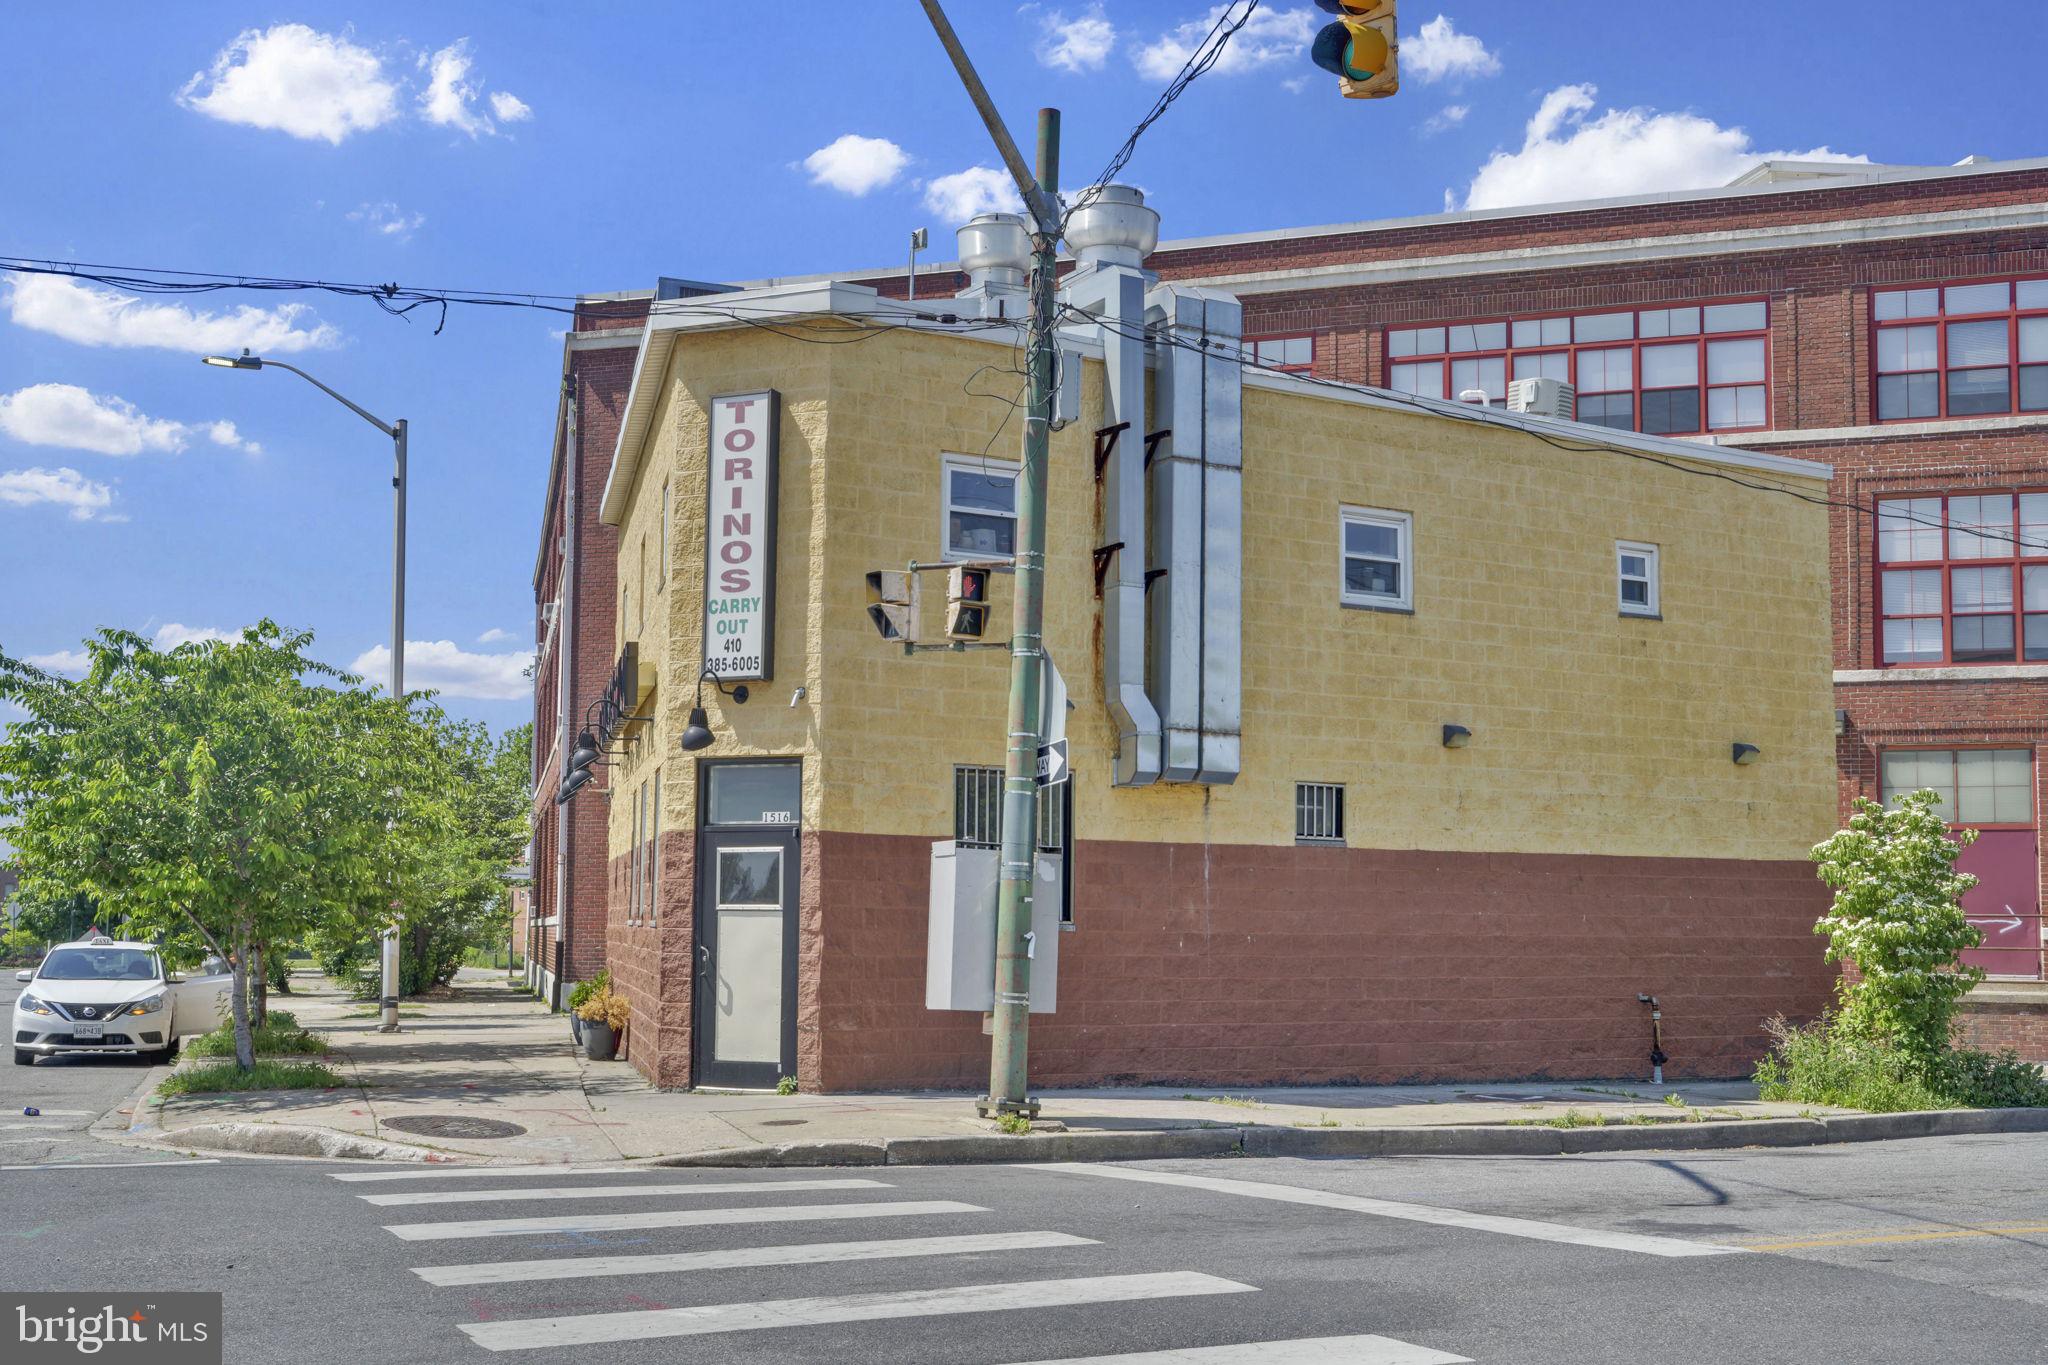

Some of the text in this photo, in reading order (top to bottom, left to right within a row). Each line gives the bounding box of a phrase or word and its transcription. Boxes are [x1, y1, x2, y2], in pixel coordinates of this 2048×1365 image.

[720, 400, 755, 593] TORINOS
[708, 597, 761, 614] CARRY
[716, 619, 748, 635] OUT
[724, 638, 742, 653] 410
[764, 812, 789, 823] 1516
